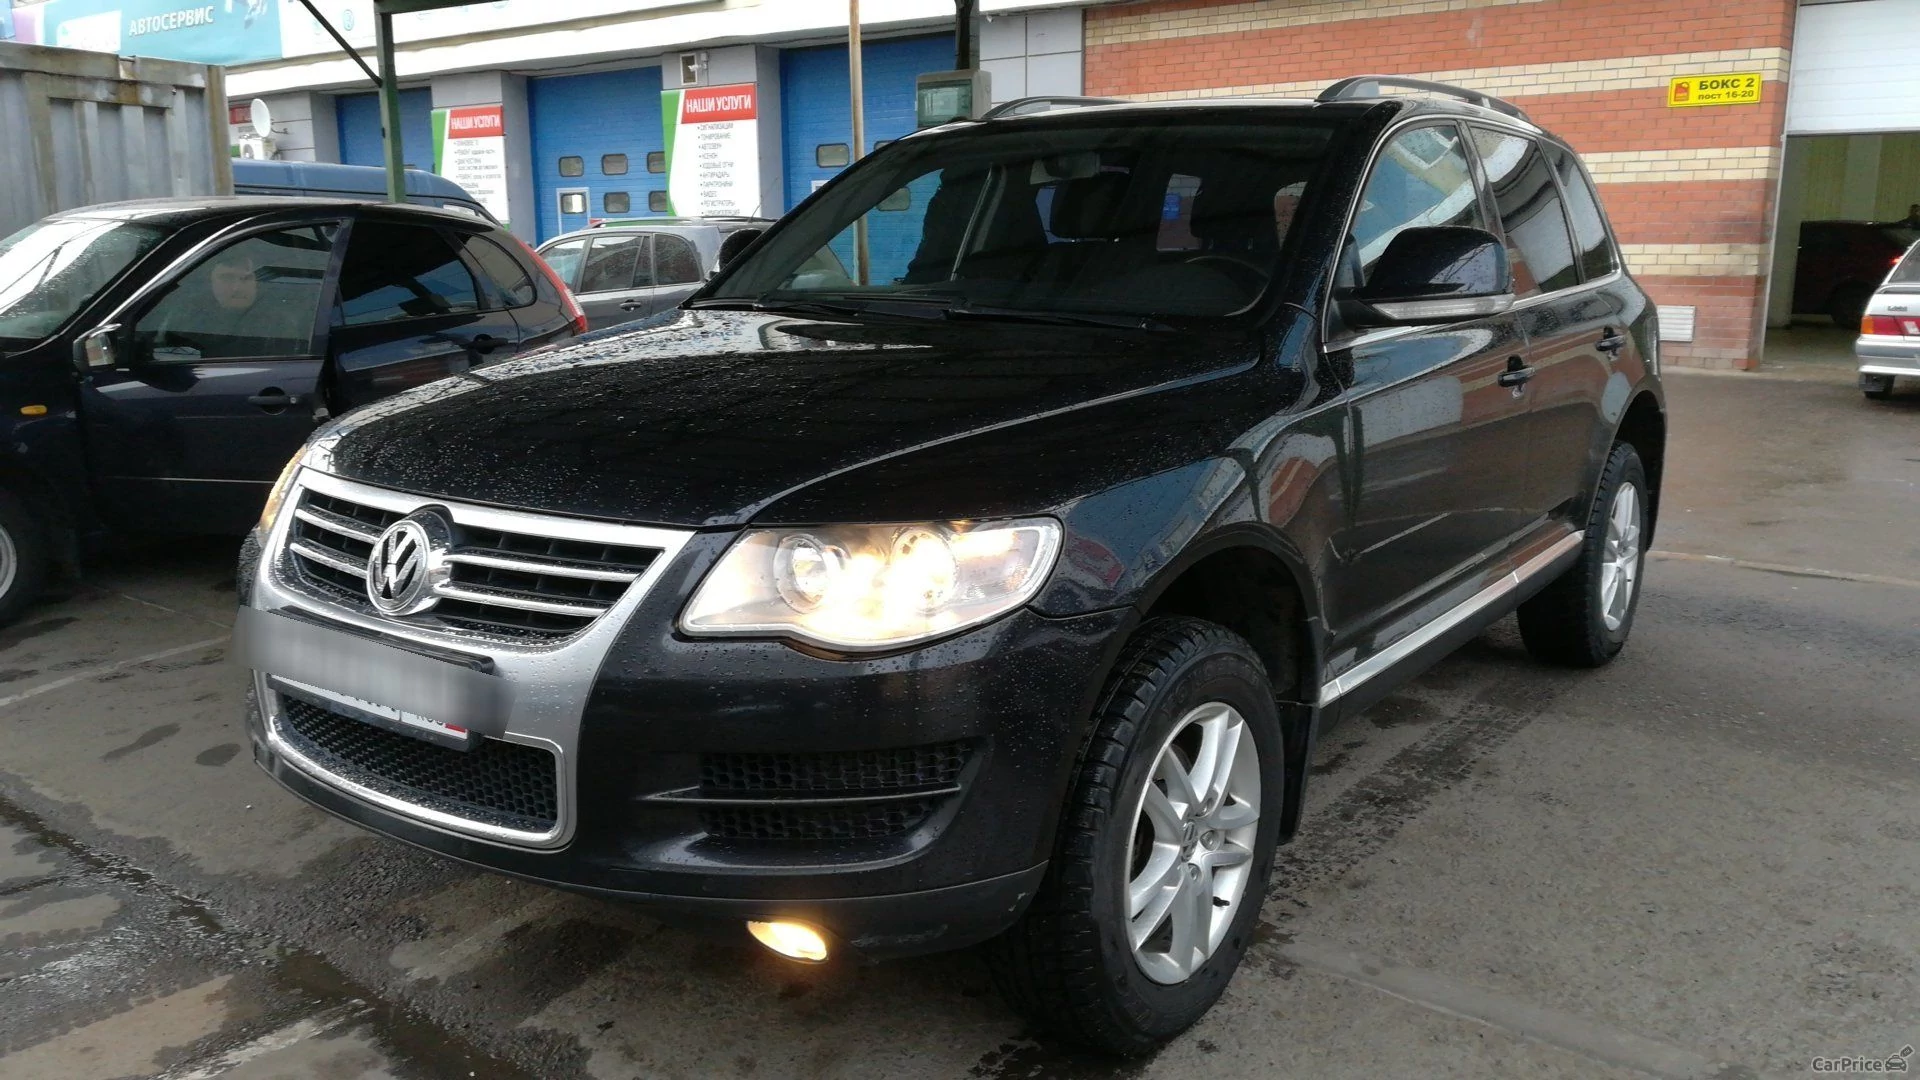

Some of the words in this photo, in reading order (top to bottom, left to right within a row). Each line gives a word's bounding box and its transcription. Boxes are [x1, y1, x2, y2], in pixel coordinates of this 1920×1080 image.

[128, 5, 214, 36] АВТОСЕРВИС
[1699, 78, 1741, 90] БОКС
[1745, 77, 1755, 88] 2
[1698, 92, 1722, 100] пост
[1726, 90, 1754, 99] 16-20
[686, 97, 715, 113] НАШИ
[716, 94, 752, 111] УСЛУГИ
[451, 116, 473, 130] НАШИ
[473, 114, 501, 128] УСЛУГИ
